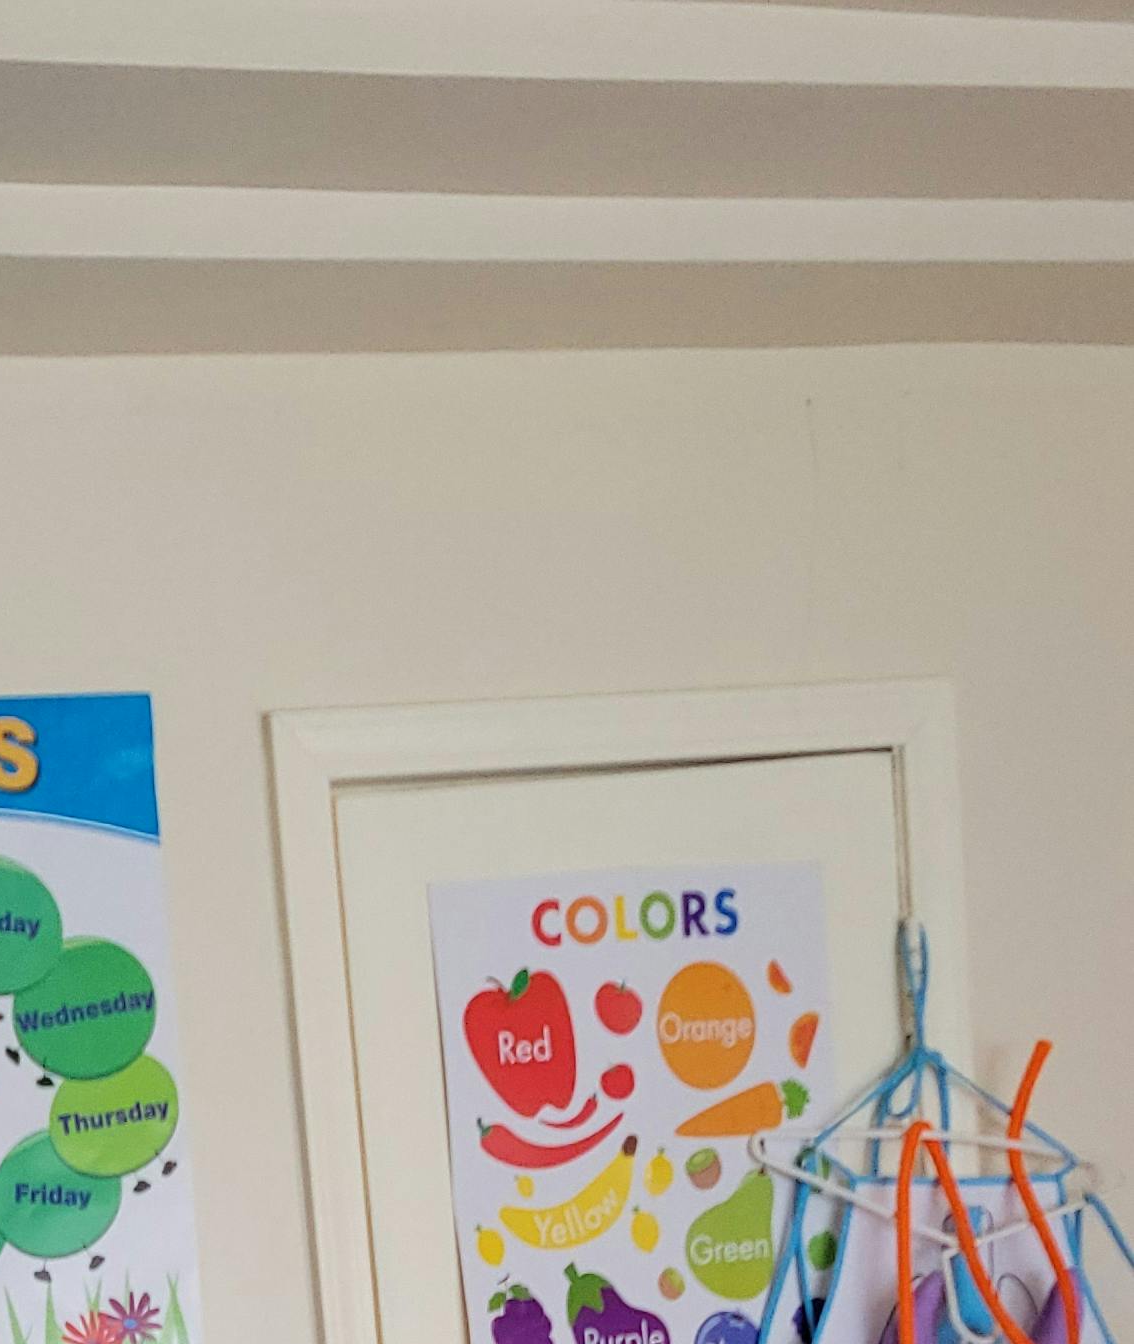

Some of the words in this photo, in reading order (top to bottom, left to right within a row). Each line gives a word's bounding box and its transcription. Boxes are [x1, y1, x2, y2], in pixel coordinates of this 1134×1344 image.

[531, 887, 739, 947] COLORS
[15, 988, 156, 1036] Wednesday
[659, 1012, 754, 1048] Orange
[497, 1025, 553, 1066] Red
[59, 1100, 169, 1136] Thursday
[14, 1183, 92, 1211] Friday
[533, 1189, 620, 1247] Yellow
[690, 1235, 770, 1267] Green
